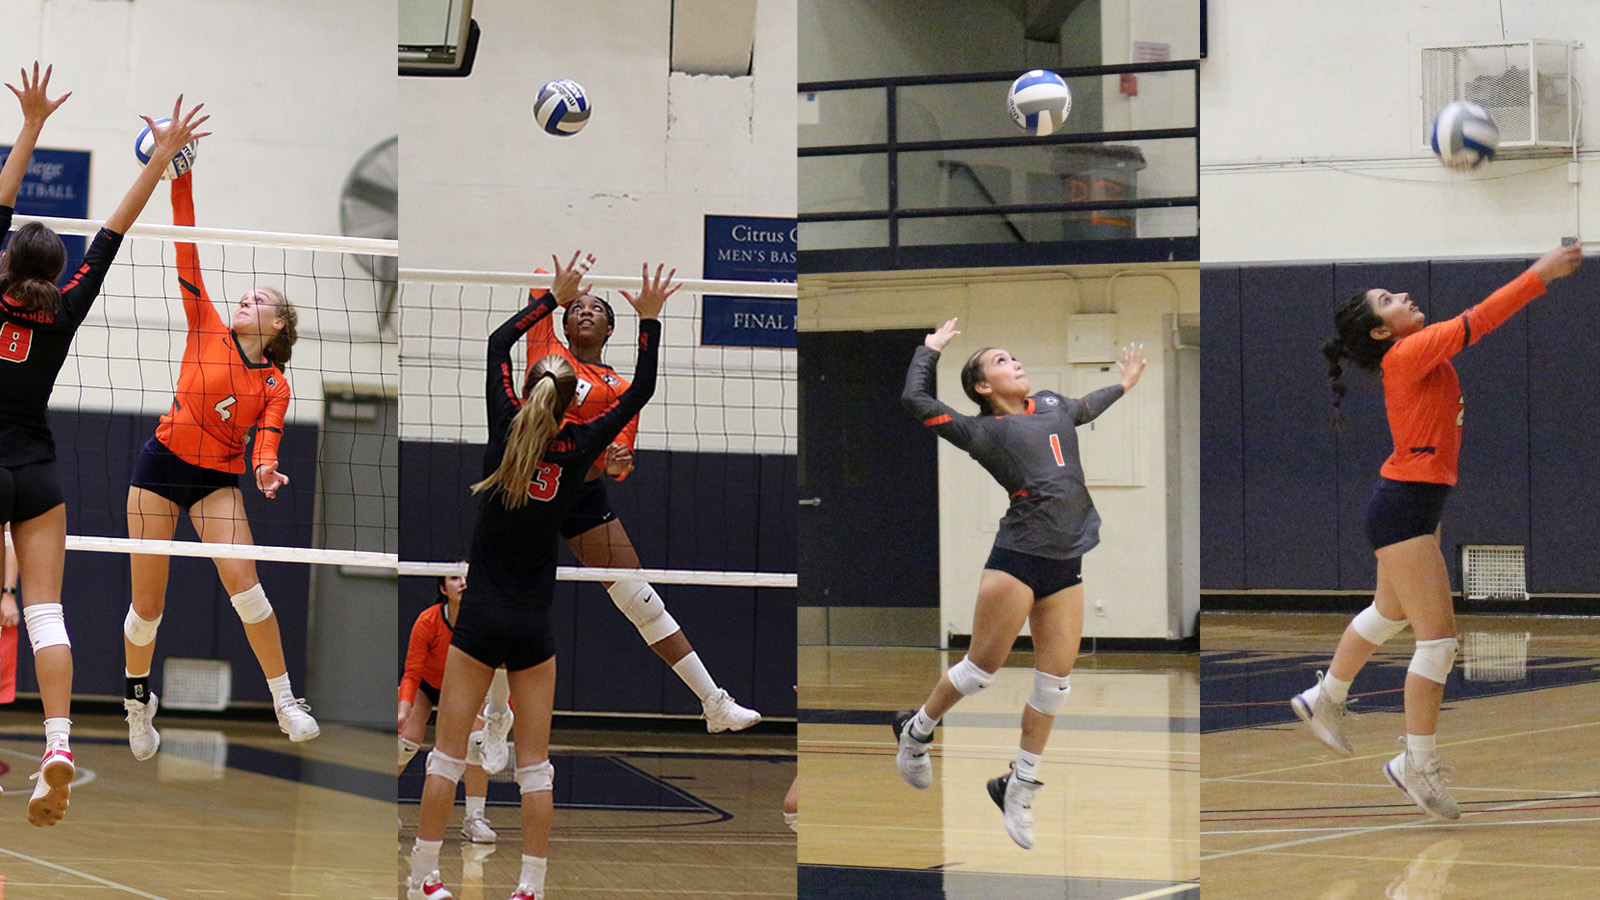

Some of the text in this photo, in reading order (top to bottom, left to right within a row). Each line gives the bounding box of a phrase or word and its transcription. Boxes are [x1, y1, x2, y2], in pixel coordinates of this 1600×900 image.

[731, 224, 785, 243] Citrus
[717, 249, 797, 264] MEN'S BAS
[733, 313, 789, 330] FINAL
[0, 321, 33, 363] 8
[214, 394, 237, 423] 4
[1049, 433, 1065, 467] 1
[526, 461, 563, 502] 3
